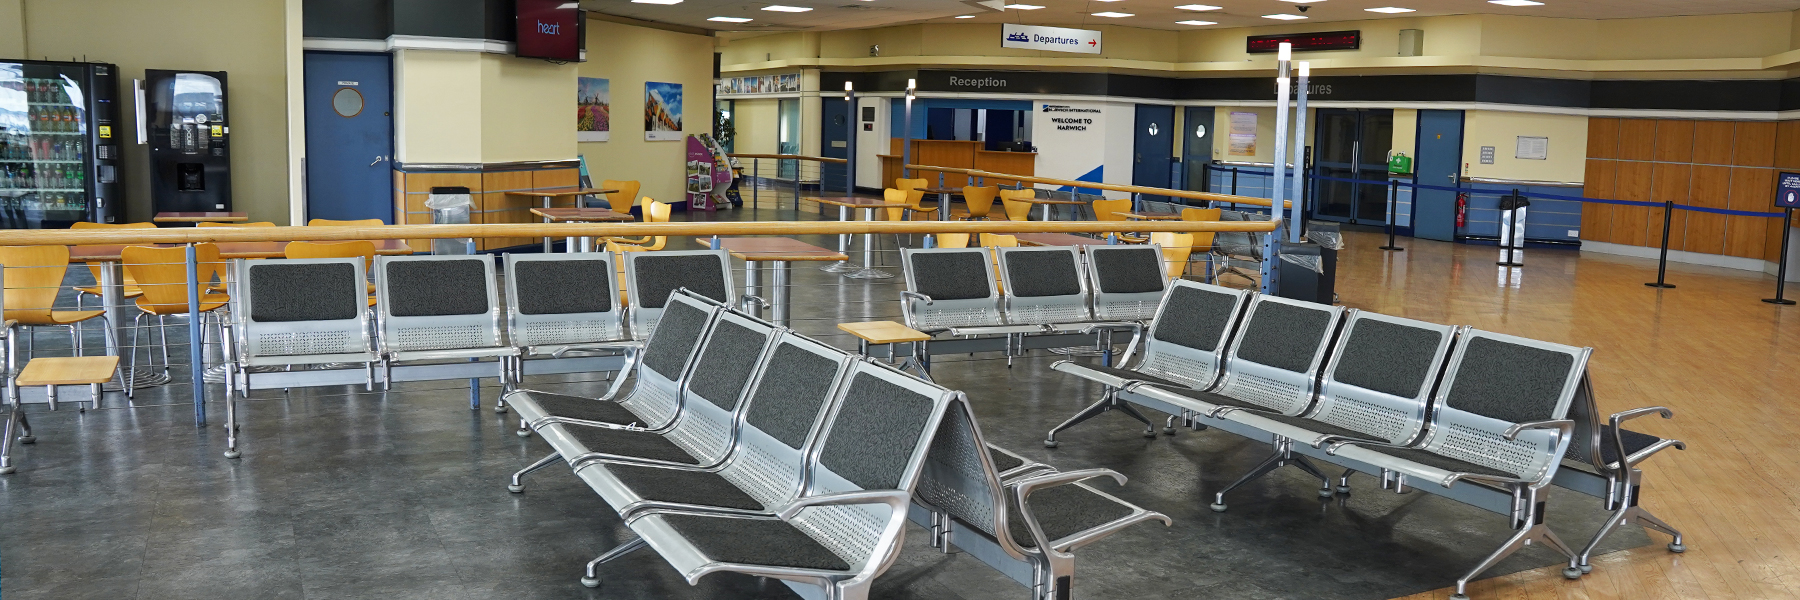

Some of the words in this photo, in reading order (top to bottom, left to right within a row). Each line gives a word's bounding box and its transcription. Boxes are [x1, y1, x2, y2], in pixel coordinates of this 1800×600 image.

[537, 19, 560, 35] heart
[1033, 34, 1079, 45] Departures
[949, 76, 1007, 88] Reception
